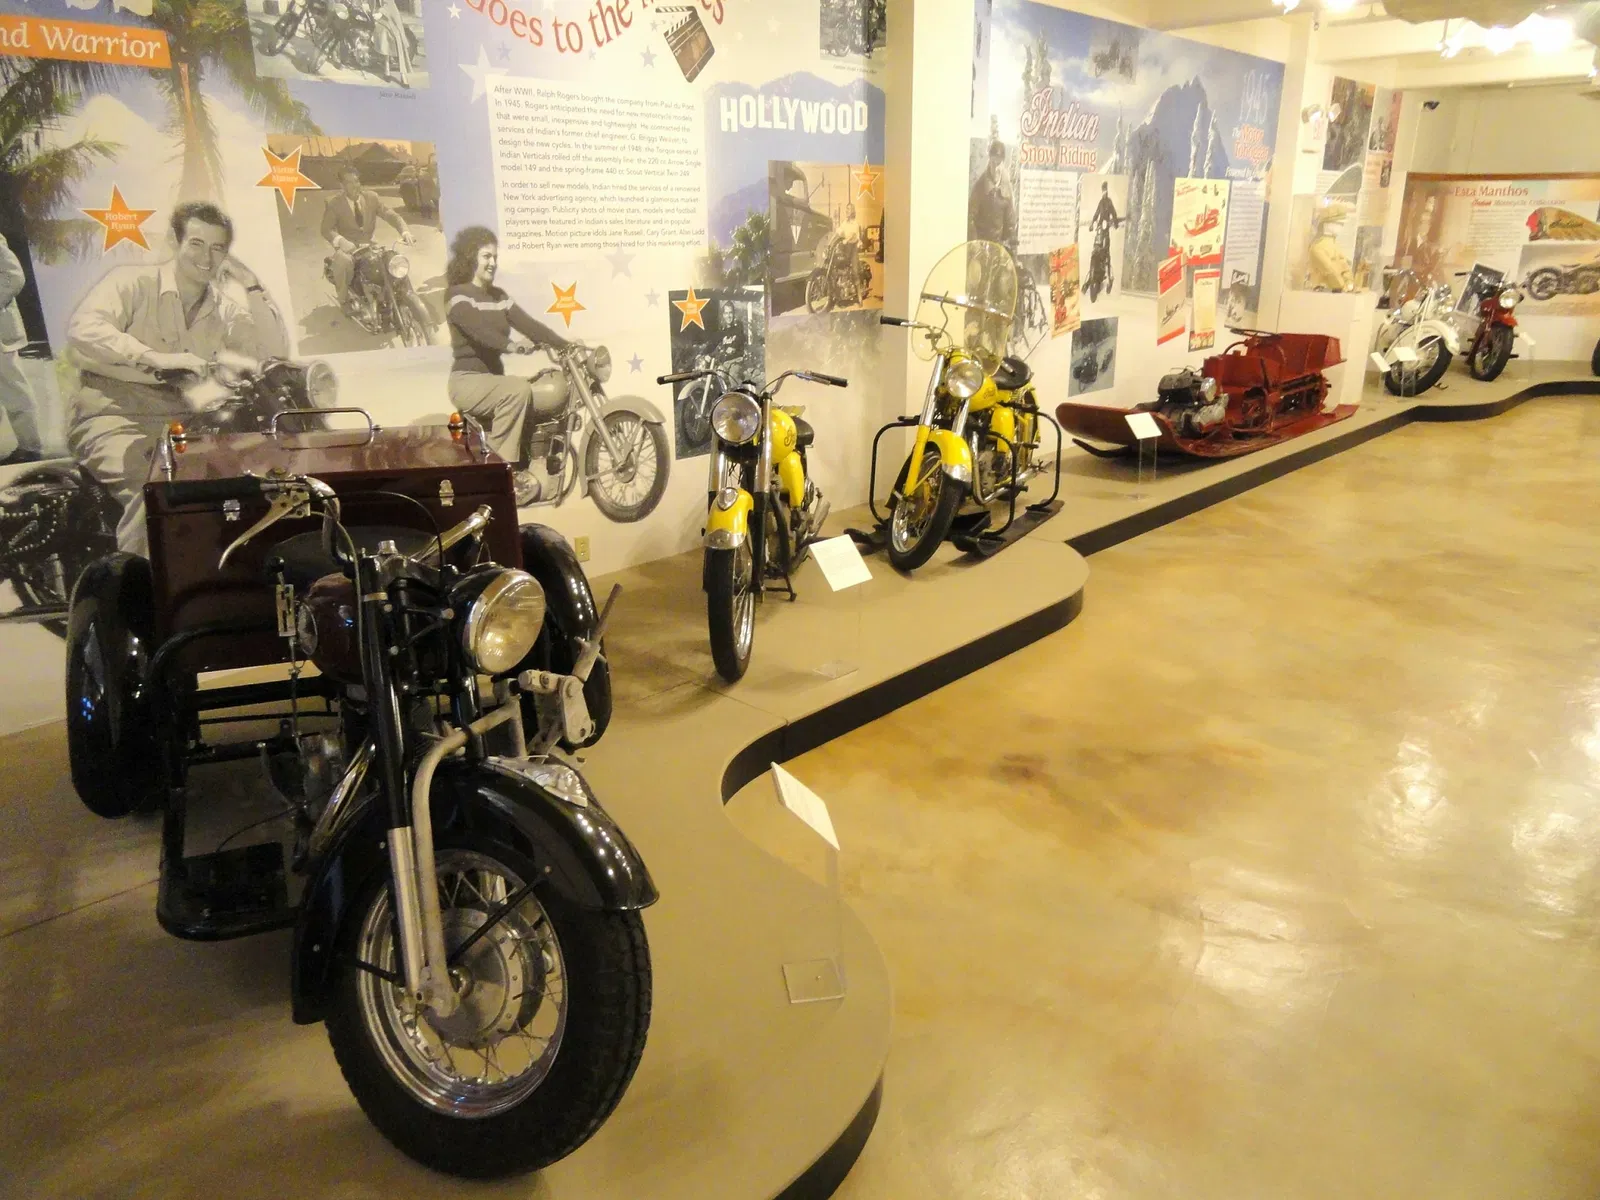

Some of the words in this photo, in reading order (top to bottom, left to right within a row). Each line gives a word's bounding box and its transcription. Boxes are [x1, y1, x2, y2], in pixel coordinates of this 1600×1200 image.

[464, 0, 544, 47] oes
[552, 16, 584, 54] to
[588, 0, 634, 48] the
[40, 25, 161, 59] Warrior
[494, 85, 512, 94] After
[536, 88, 555, 99] Ralph
[557, 91, 579, 101] Rogers
[580, 93, 604, 104] bought
[617, 98, 644, 108] company
[525, 101, 548, 111] Rogers
[550, 104, 586, 113] anticipated
[599, 108, 615, 116] need
[640, 112, 672, 120] motorcycle
[673, 114, 692, 122] models
[719, 94, 868, 135] HOLLYWOOD
[1020, 87, 1100, 142] Indian
[496, 112, 510, 120] that
[551, 117, 589, 126] inexpensive
[590, 119, 602, 127] and
[497, 126, 525, 134] services
[535, 128, 560, 136] Indian's
[561, 129, 583, 137] former
[585, 130, 600, 138] chief
[499, 138, 521, 148] design
[524, 138, 534, 146] the
[582, 142, 592, 150] the
[656, 146, 675, 155] Torque
[499, 150, 521, 159] Indian
[522, 151, 550, 160] Verticals
[552, 153, 571, 161] rolled
[572, 153, 581, 161] off
[594, 156, 621, 164] assembly
[685, 159, 701, 168] Single
[1021, 141, 1056, 164] Snow
[1059, 144, 1098, 173] Riding
[501, 163, 522, 171] model
[539, 181, 550, 189] sell
[1480, 184, 1530, 198] Manthos
[503, 193, 519, 201] New
[521, 193, 536, 201] York
[538, 193, 573, 203] advertising
[105, 212, 137, 221] Robert
[504, 206, 515, 215] ing
[552, 205, 579, 215] Publicity
[676, 206, 696, 214] football
[111, 222, 136, 232] Ryan
[505, 218, 530, 227] players
[549, 217, 576, 225] featured
[625, 217, 651, 225] literature
[670, 218, 691, 226] popular
[569, 230, 591, 238] picture
[592, 229, 607, 237] idols
[609, 229, 622, 237] Jane
[646, 229, 659, 238] Cary
[507, 242, 520, 250] and
[521, 241, 545, 249] Robert
[546, 241, 562, 251] Ryan
[580, 242, 602, 250] among
[602, 240, 620, 248] those
[646, 239, 657, 247] this
[658, 239, 685, 247] marketing
